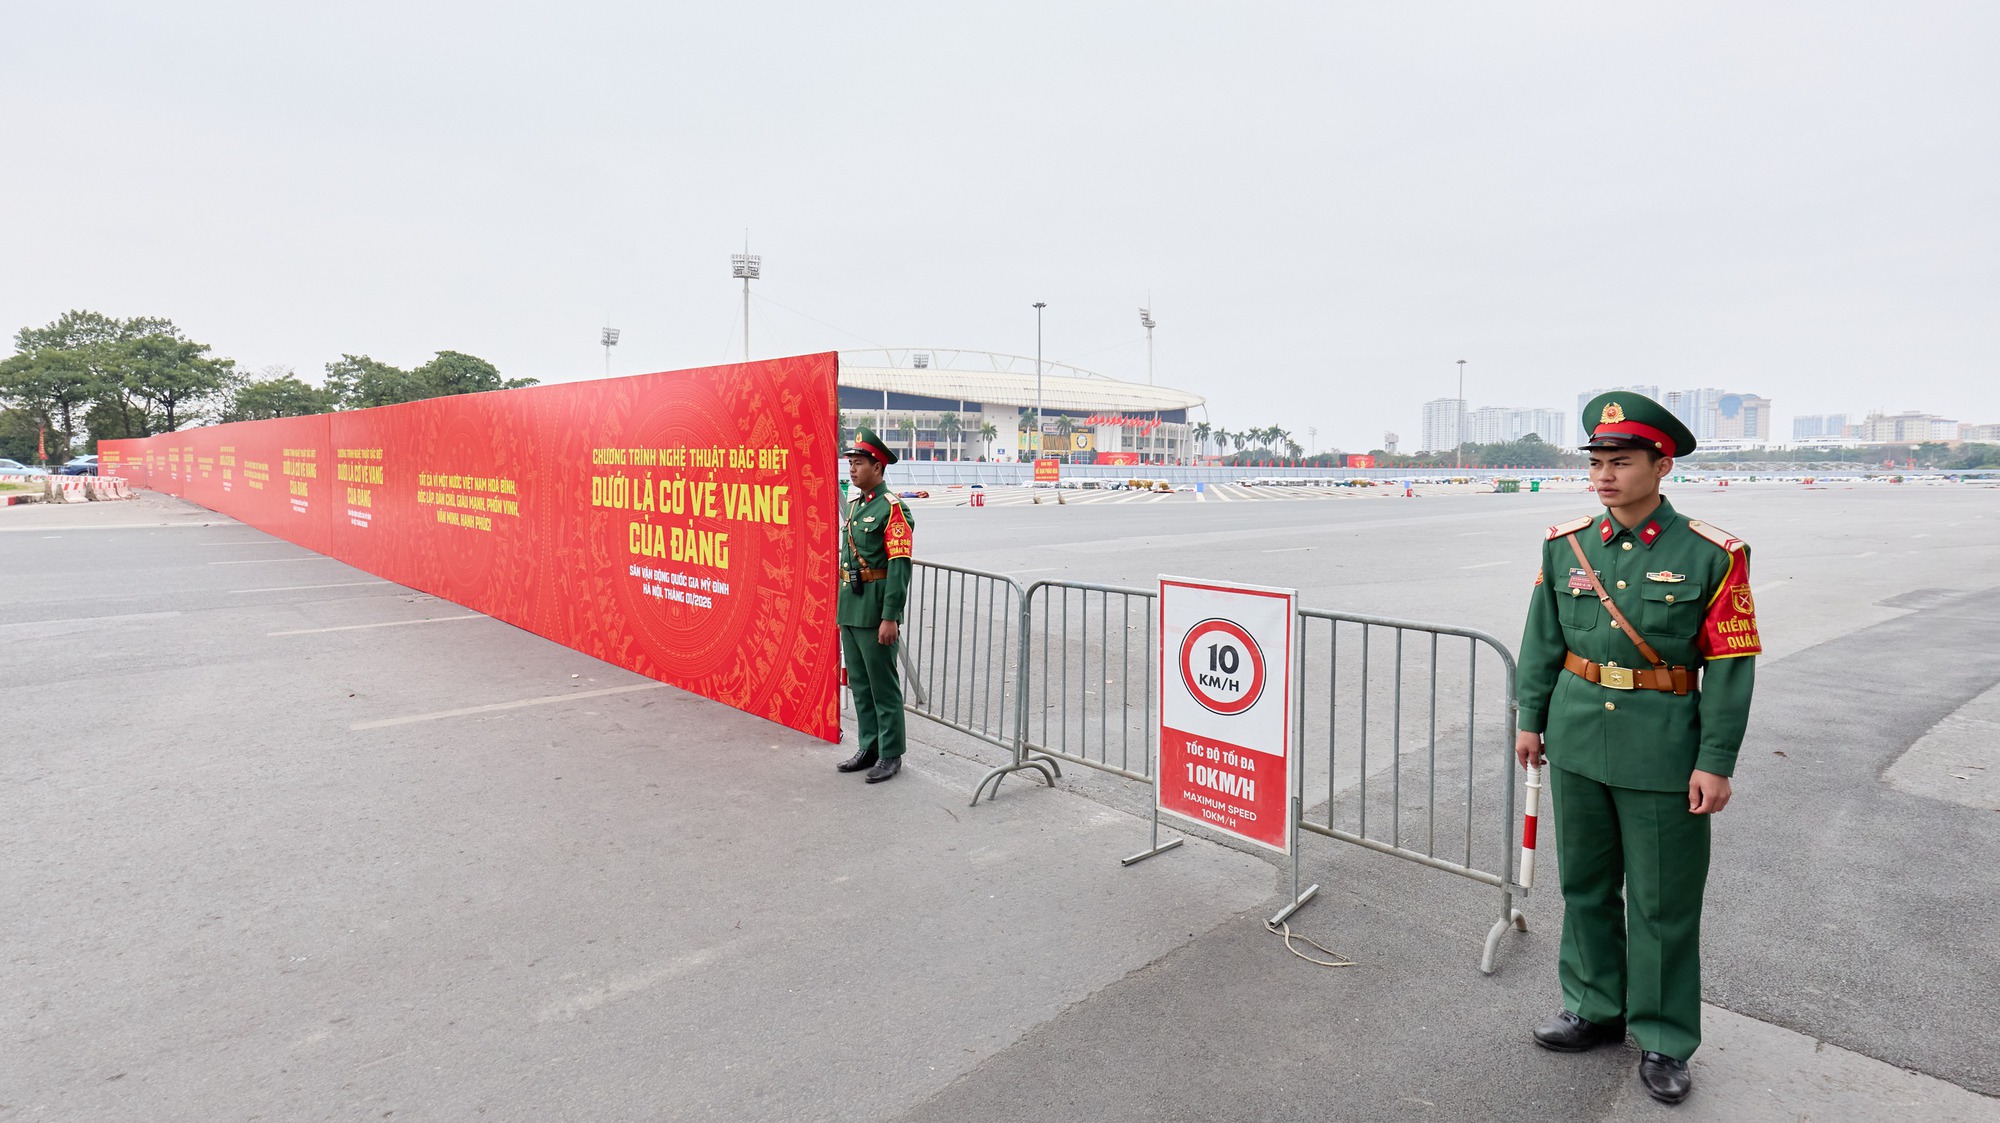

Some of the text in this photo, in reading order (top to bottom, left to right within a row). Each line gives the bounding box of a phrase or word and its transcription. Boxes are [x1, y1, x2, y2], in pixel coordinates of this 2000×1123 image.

[592, 445, 789, 475] CHƯƠNG TRÌNH NGHỆ THUẬT ĐẶC BIỆT
[474, 478, 487, 491] NAM
[592, 471, 789, 525] DƯỚI LÁ CỜ VẺ VANG
[629, 514, 729, 570] CỦA ĐẢNG
[630, 564, 730, 596] SÂN VẬN ĐỘNG QUỐC GIA MỸ ĐÌNH
[643, 582, 651, 594] HÀ
[664, 588, 685, 602] THÁNG
[686, 592, 712, 609] 01/2026
[1717, 616, 1751, 634] KIỂM
[1207, 643, 1240, 675] 10
[1199, 673, 1240, 693] KM/H
[1186, 740, 1255, 772] TỐC ĐỘ TỐI ĐA
[1186, 762, 1255, 802] 10KM/H
[1183, 789, 1257, 822] MAXIMUM SPEED
[1202, 808, 1236, 828] 10KM/H
